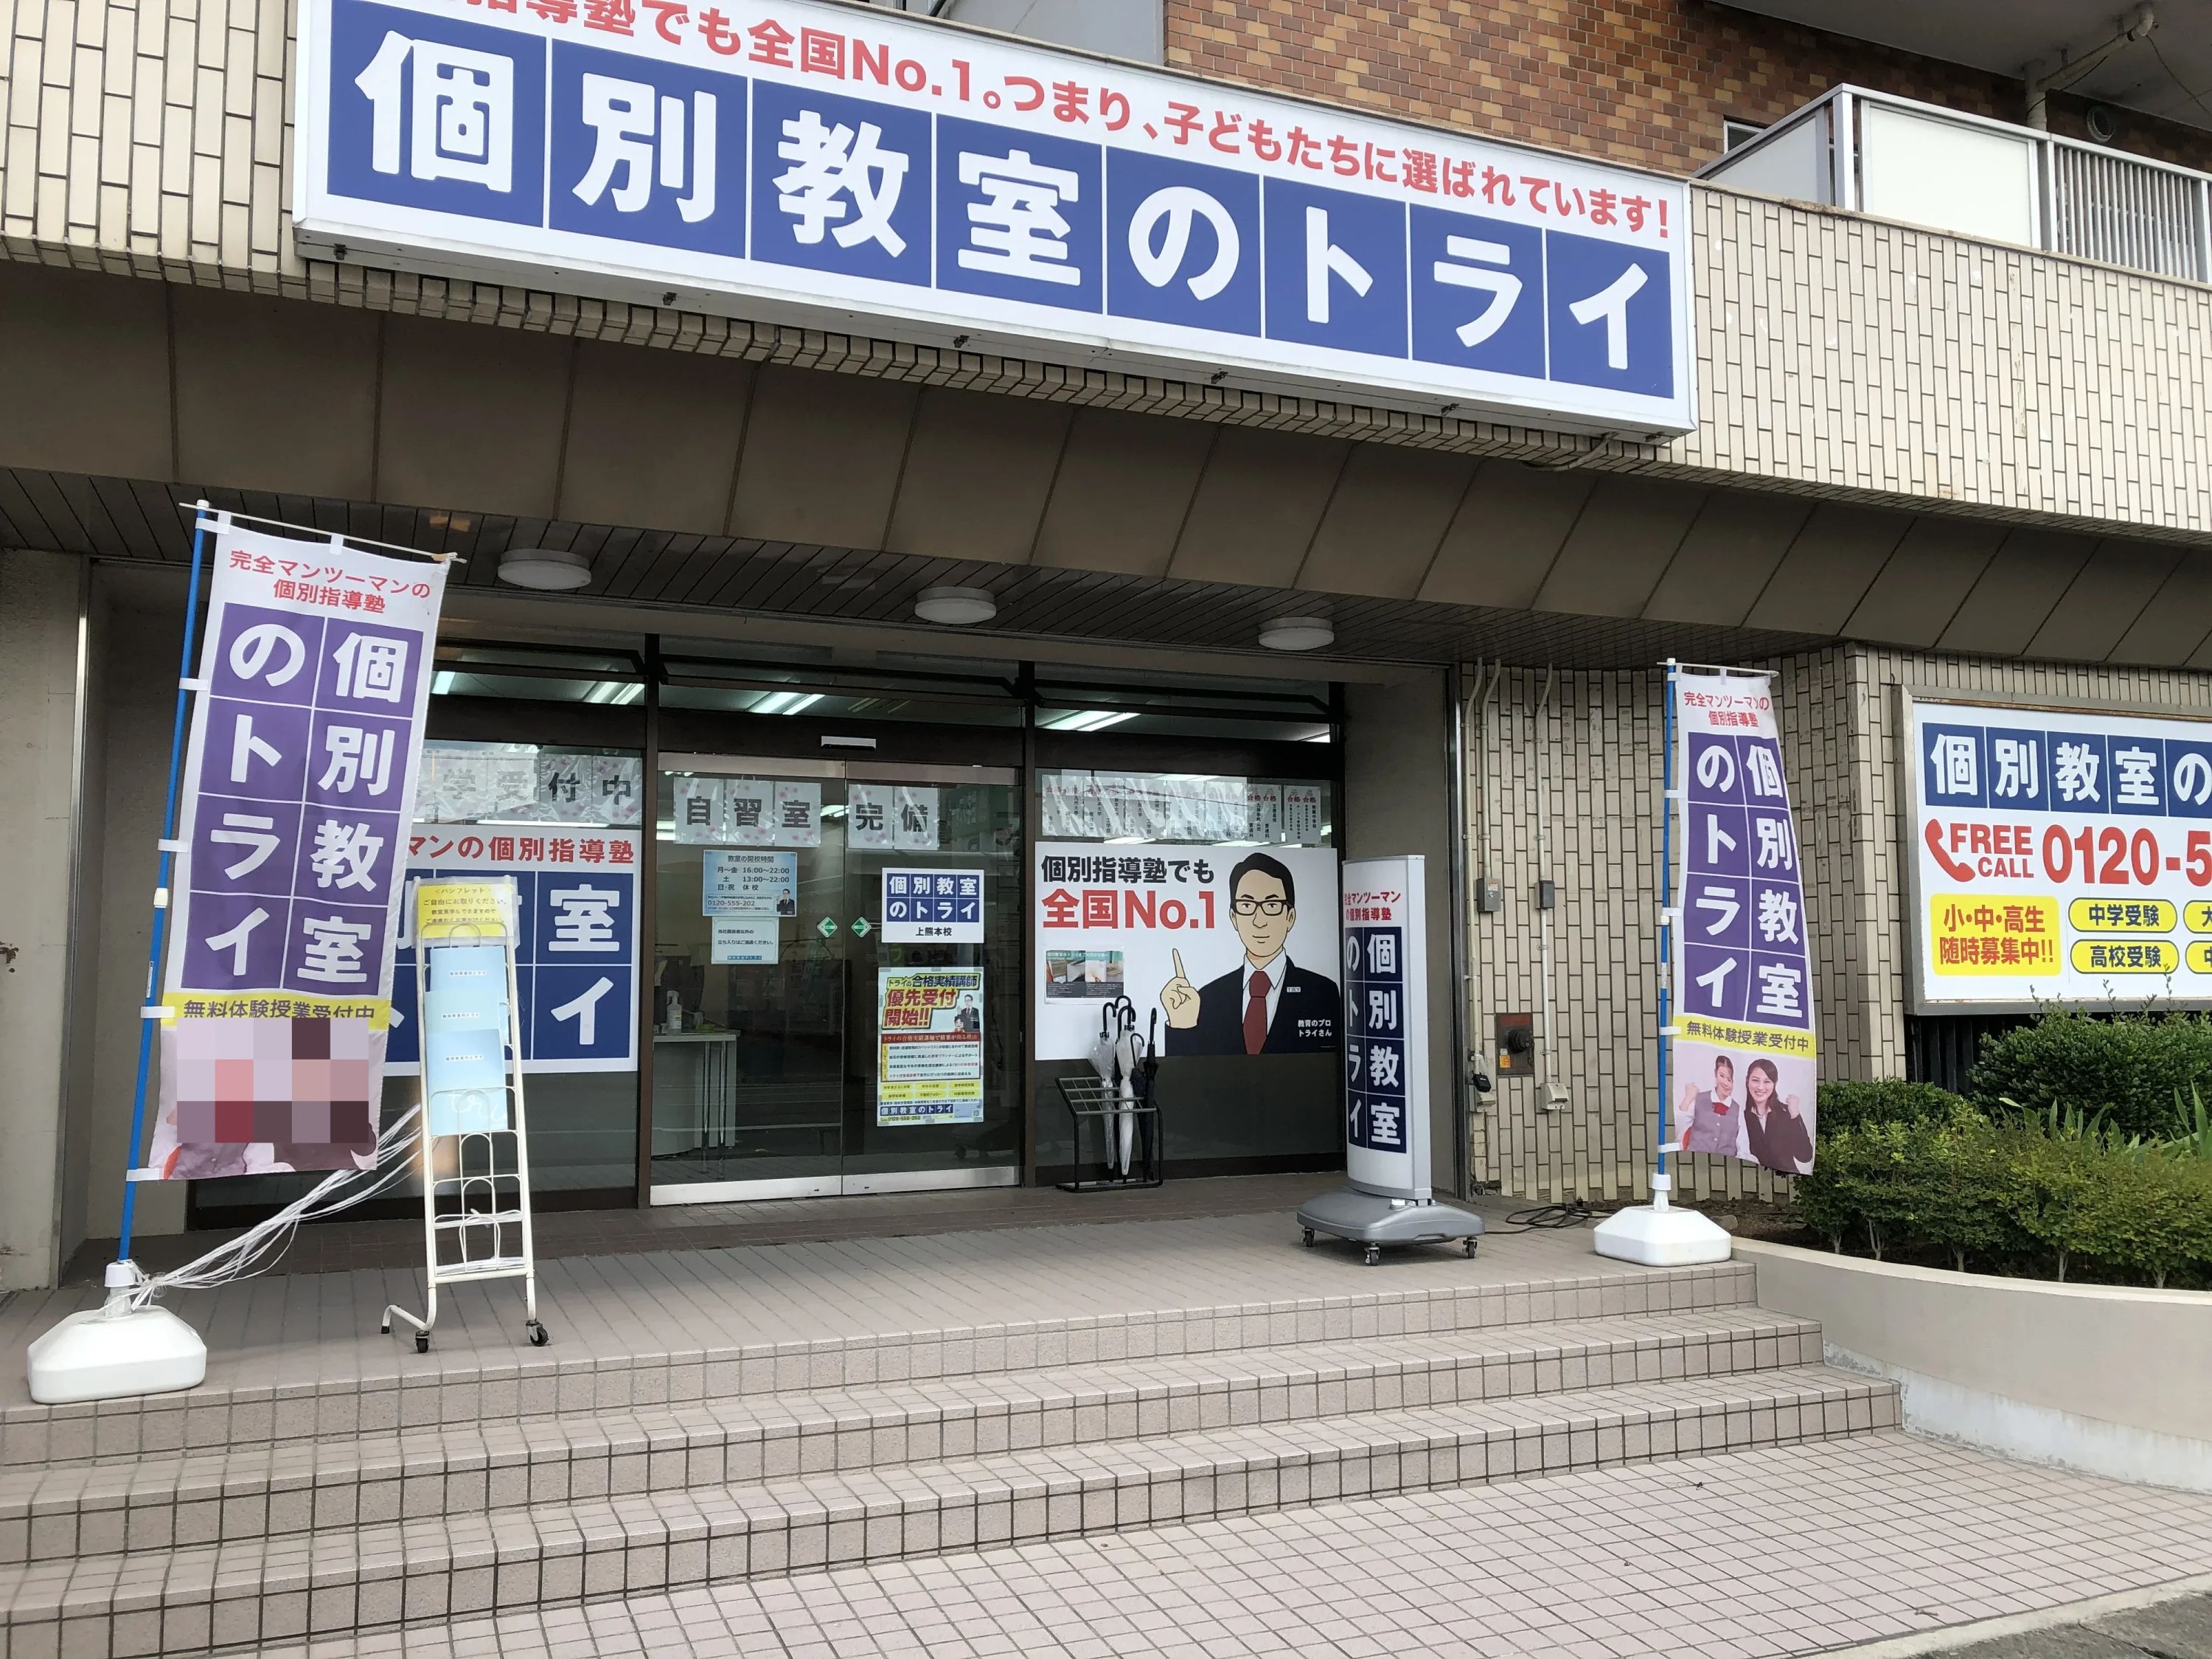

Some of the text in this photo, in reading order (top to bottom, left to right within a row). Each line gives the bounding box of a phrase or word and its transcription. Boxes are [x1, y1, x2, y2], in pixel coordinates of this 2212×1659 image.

[466, 0, 1668, 237] 塾でも全国No.1。つまり、子どもたちに選ばれています!
[355, 30, 1647, 370] 個別教室のトライ
[229, 550, 430, 599] 完全マンツーマンの
[274, 580, 385, 613] 個別指導塾
[1684, 691, 1769, 710] 完全マンツーマンの
[1708, 711, 1759, 727] 個別指導塾
[1930, 733, 2212, 806] 個別教室の
[205, 624, 305, 975] のトライ
[297, 633, 408, 982] 個別教室
[1950, 823, 2033, 855] FREE
[1978, 857, 2034, 878] CALL
[2042, 824, 2212, 886] 0120-5
[1041, 856, 1214, 884] 個別指導塾でも
[1696, 745, 1740, 1007] のトライ
[1746, 745, 1802, 1018] 個別教室
[889, 876, 976, 895] 個別教室
[889, 901, 975, 919] のトライ
[1042, 888, 1214, 929] 全国No.1
[2088, 904, 2160, 927] 中学受験
[915, 927, 952, 936] 上熊本校
[1939, 937, 2053, 965] 随時募集中!!
[2090, 945, 2161, 968] 高校受験
[888, 975, 977, 987] トライの合格実績講師
[887, 989, 956, 1006] 優先受付
[885, 1009, 929, 1026] 開始!!
[1298, 1019, 1331, 1027] 教育のプロ
[1298, 1029, 1332, 1037] トライさん
[1367, 933, 1401, 1145] 個別教室
[1687, 1021, 1809, 1051] 無料体験授業受付中
[881, 1105, 953, 1116] 個別教室のトライ
